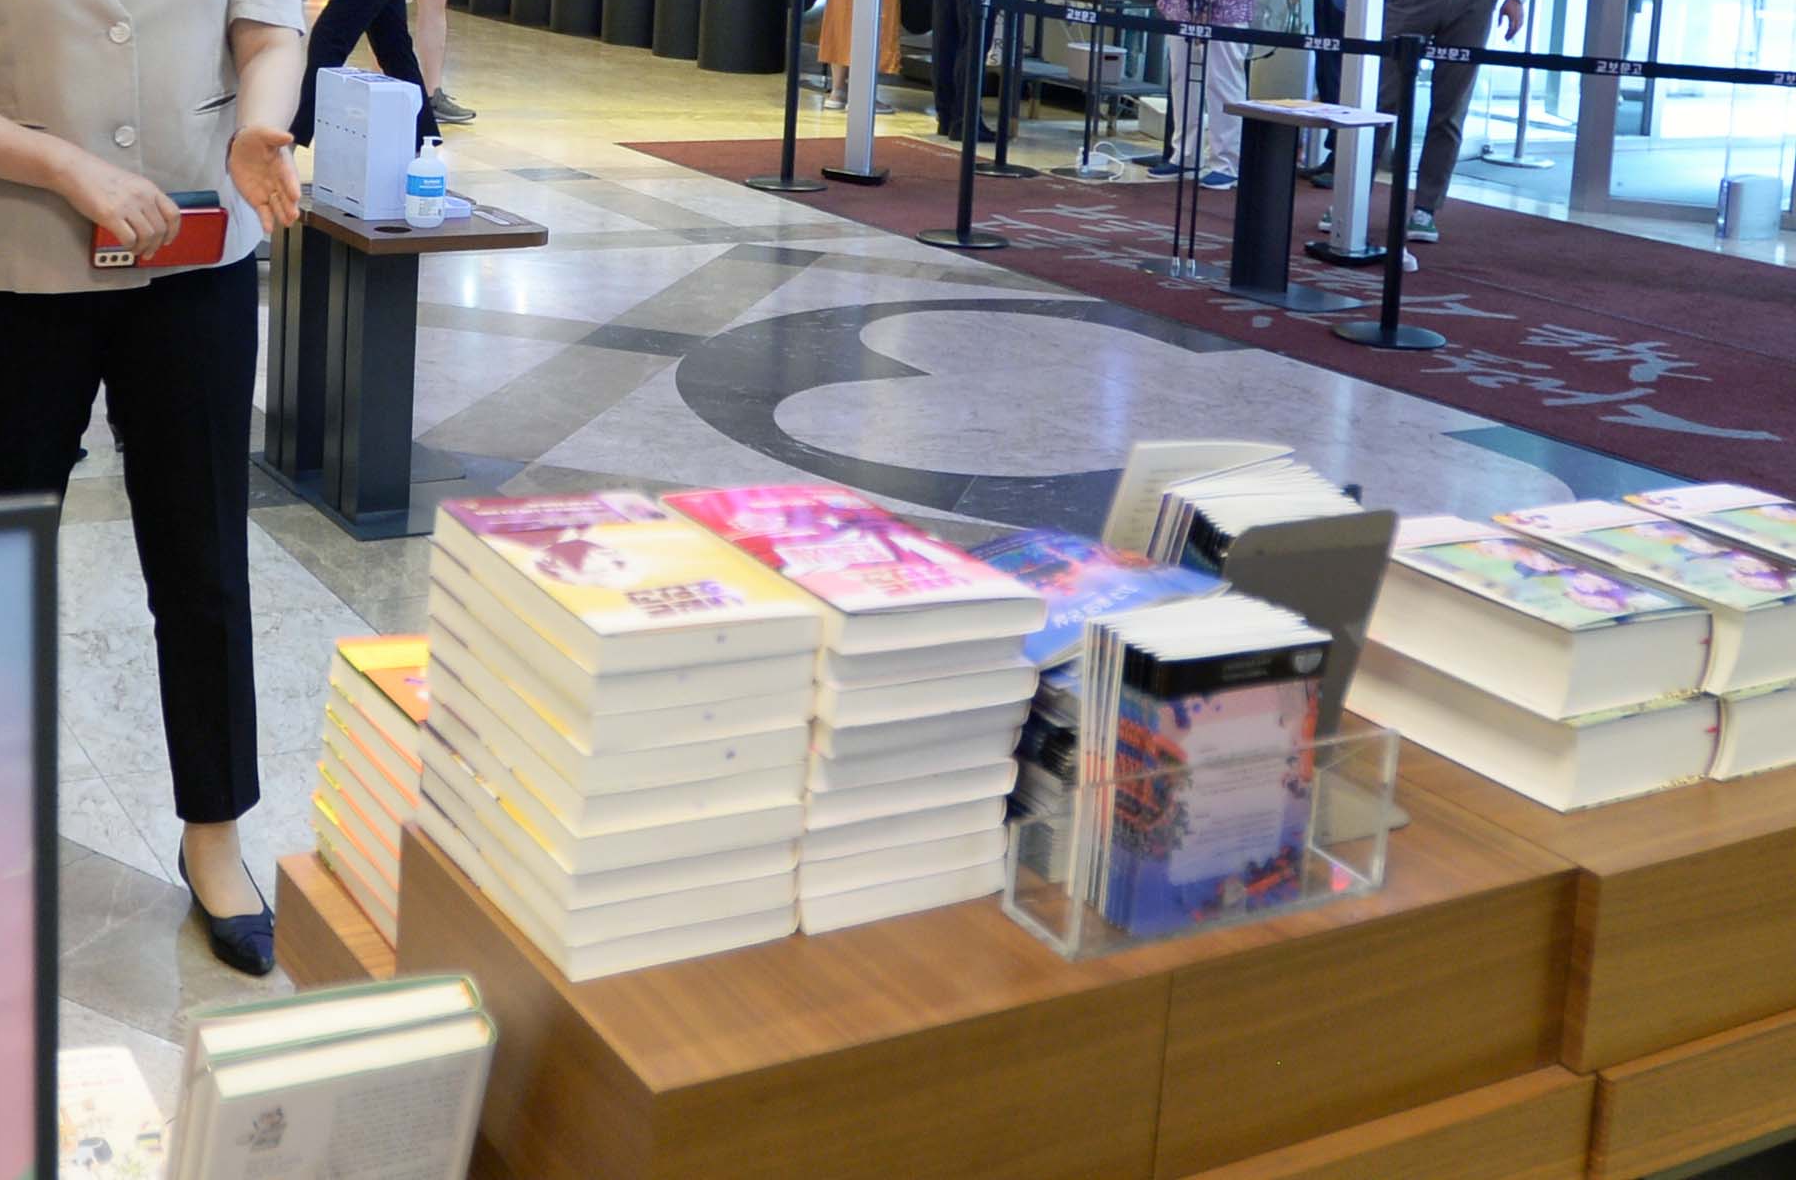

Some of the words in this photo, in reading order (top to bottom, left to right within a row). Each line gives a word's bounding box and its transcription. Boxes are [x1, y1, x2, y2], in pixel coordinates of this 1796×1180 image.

[1066, 7, 1097, 22] 교보문고
[1179, 23, 1213, 38] 교보문고
[1304, 37, 1341, 51] 교보문고
[1424, 46, 1471, 61] 교보문고
[1596, 60, 1643, 76] 교보문고
